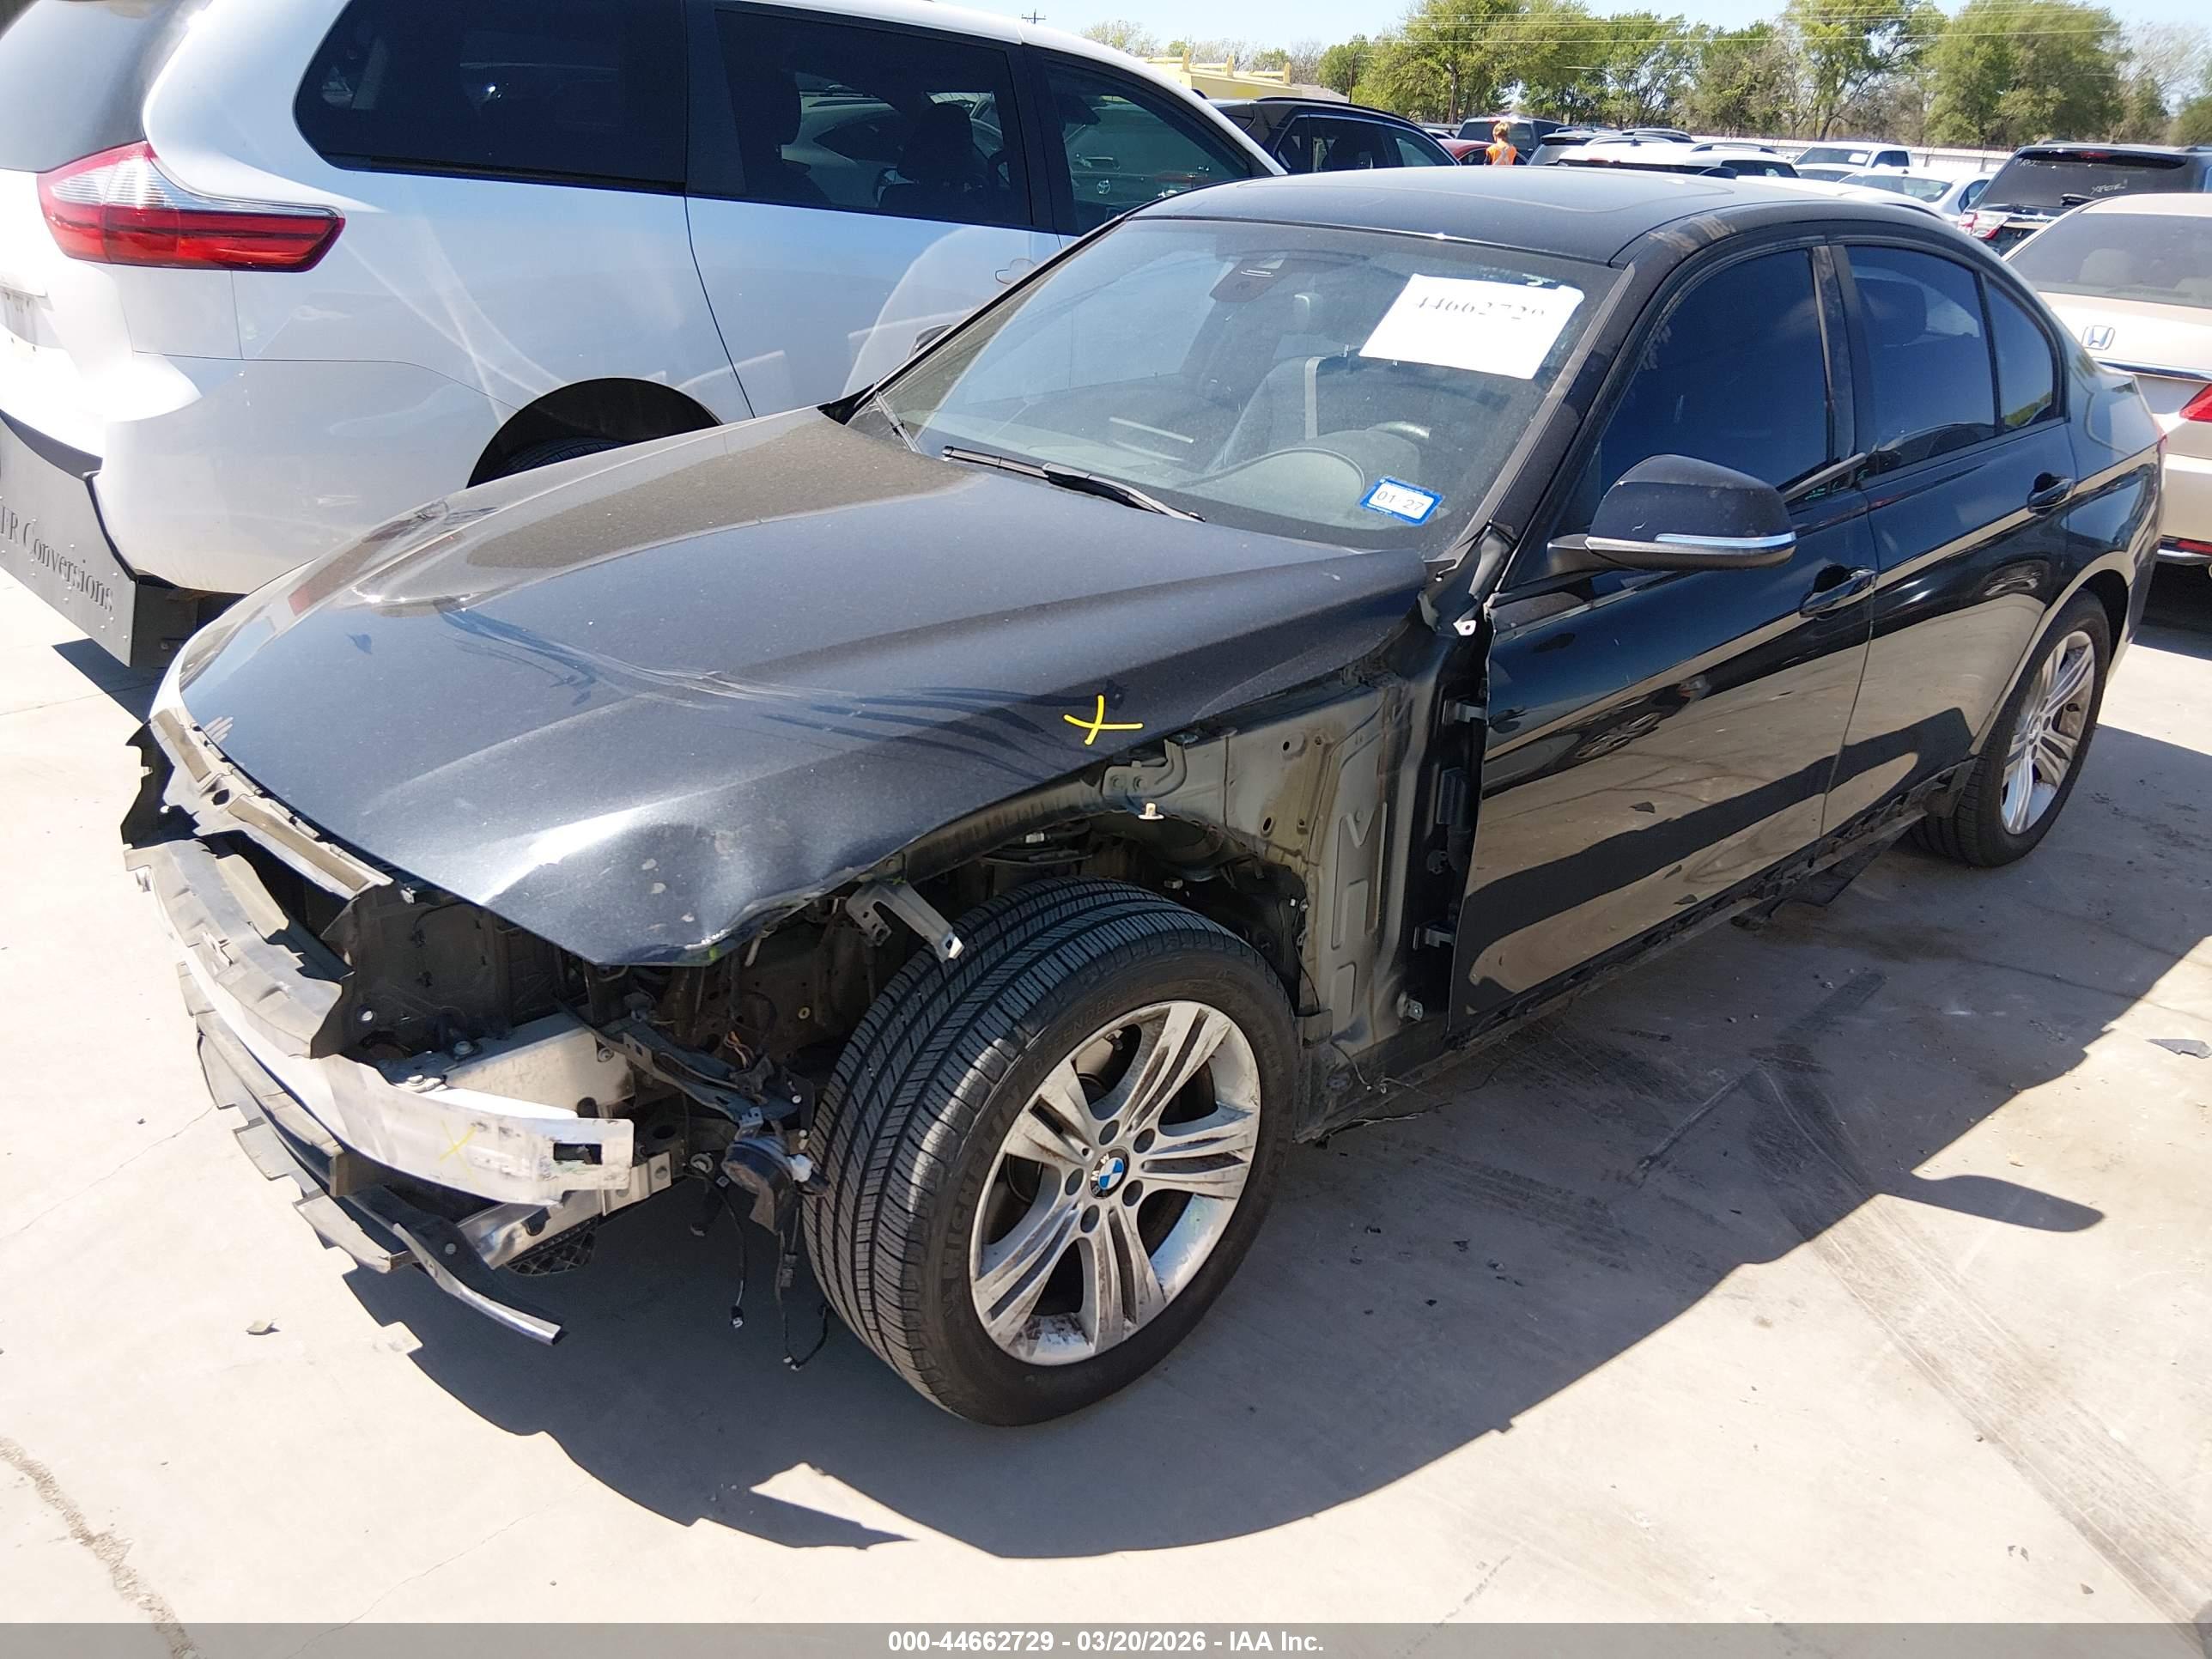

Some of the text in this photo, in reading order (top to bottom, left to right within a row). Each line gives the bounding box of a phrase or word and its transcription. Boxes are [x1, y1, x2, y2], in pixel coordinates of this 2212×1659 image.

[1402, 498, 1425, 512] 27
[22, 521, 113, 612] Conversions
[1090, 1152, 1110, 1195] BMW
